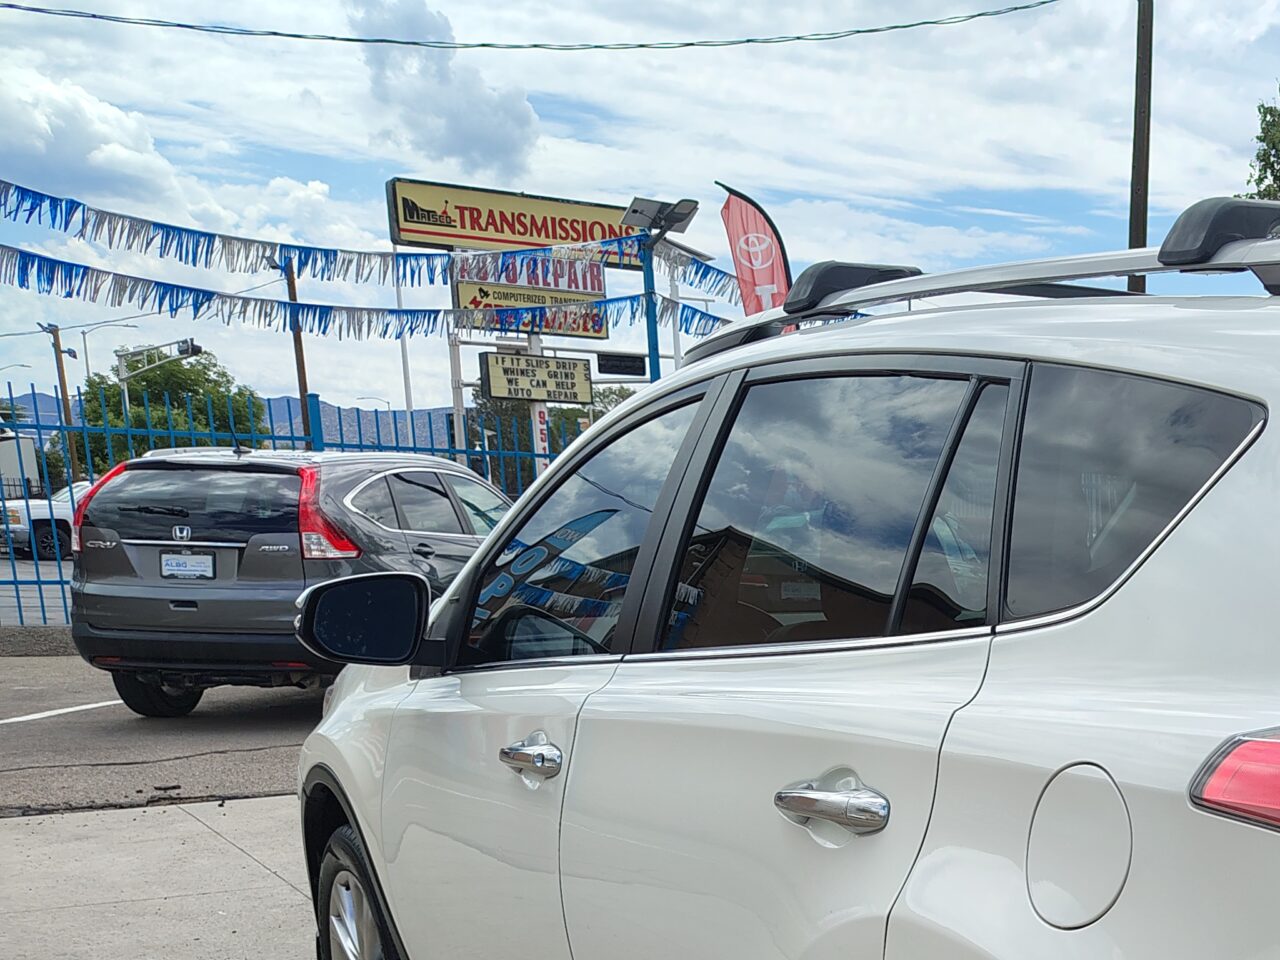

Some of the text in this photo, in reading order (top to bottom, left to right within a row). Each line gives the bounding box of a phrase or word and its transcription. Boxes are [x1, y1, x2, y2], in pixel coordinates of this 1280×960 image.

[459, 253, 604, 292] AUO REPAIR
[492, 290, 547, 305] COMPUTERIZED
[511, 357, 521, 367] IT
[525, 359, 551, 369] SLIPS
[556, 361, 577, 371] DRIP
[502, 367, 537, 378] WHINES
[547, 370, 576, 380] GRIND
[506, 377, 576, 390] WE CAN HELP
[507, 387, 578, 400] AUTO REPAIR
